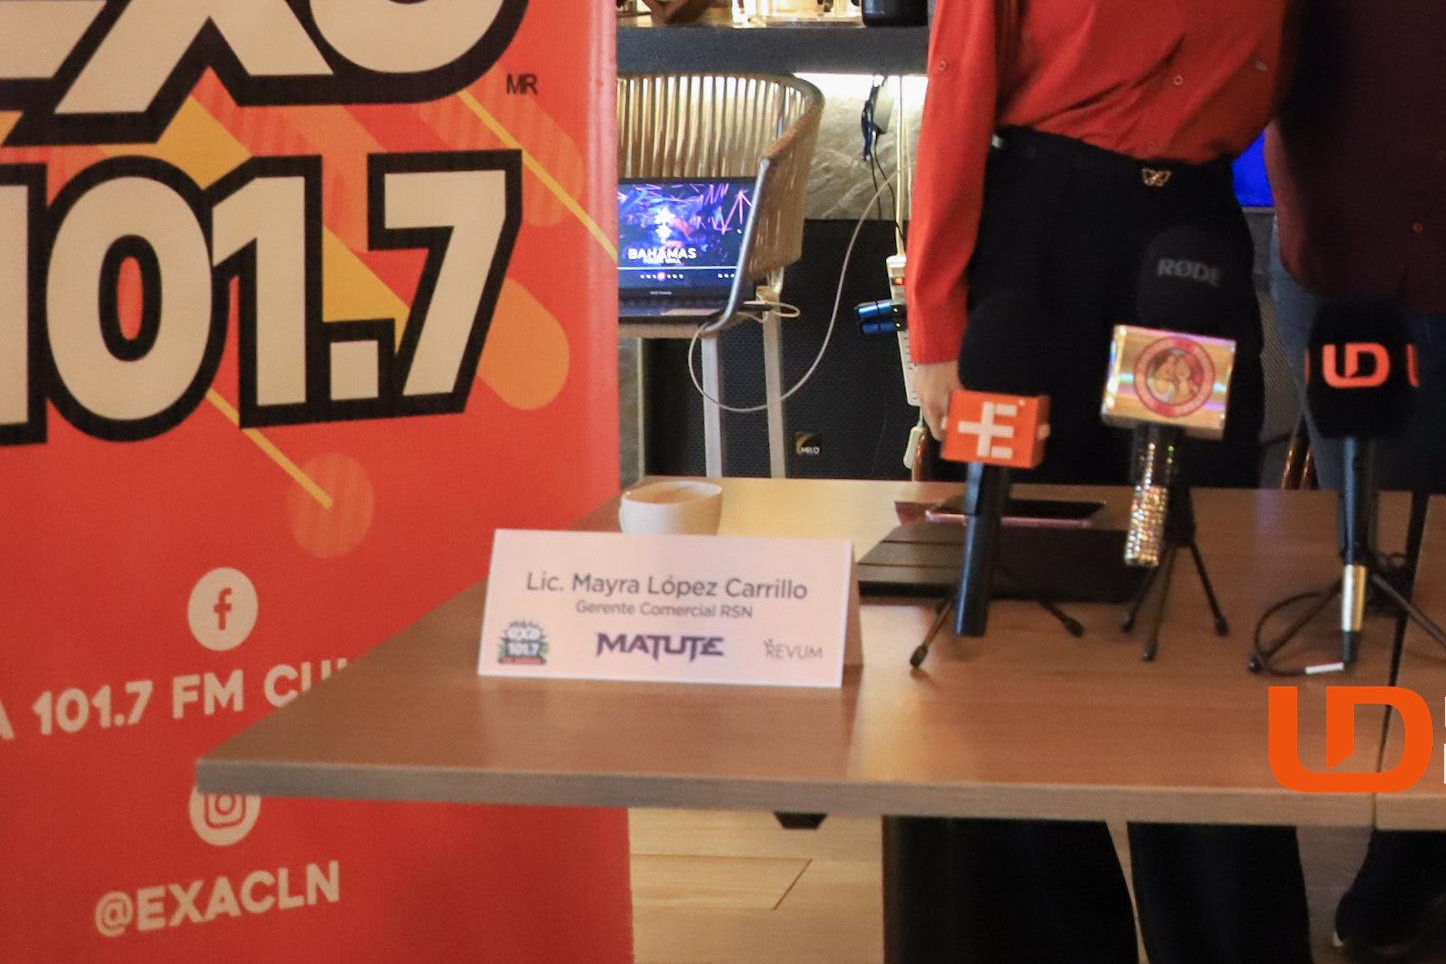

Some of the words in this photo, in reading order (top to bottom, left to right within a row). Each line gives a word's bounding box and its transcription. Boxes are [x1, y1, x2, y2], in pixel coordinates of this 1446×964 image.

[506, 73, 539, 96] MR
[628, 247, 697, 260] BAHAMAS
[526, 572, 565, 592] Lic.
[572, 572, 640, 597] Mayra
[647, 574, 718, 599] López
[725, 577, 808, 600] Carrillo
[575, 599, 636, 615] Gerente
[640, 602, 716, 618] Comercial
[720, 604, 753, 619] RSN
[597, 632, 725, 663] MATUTE
[764, 641, 824, 660] REVUM
[32, 680, 153, 735] 101.7
[172, 669, 244, 720] FM
[94, 861, 341, 937] @EXACLN
